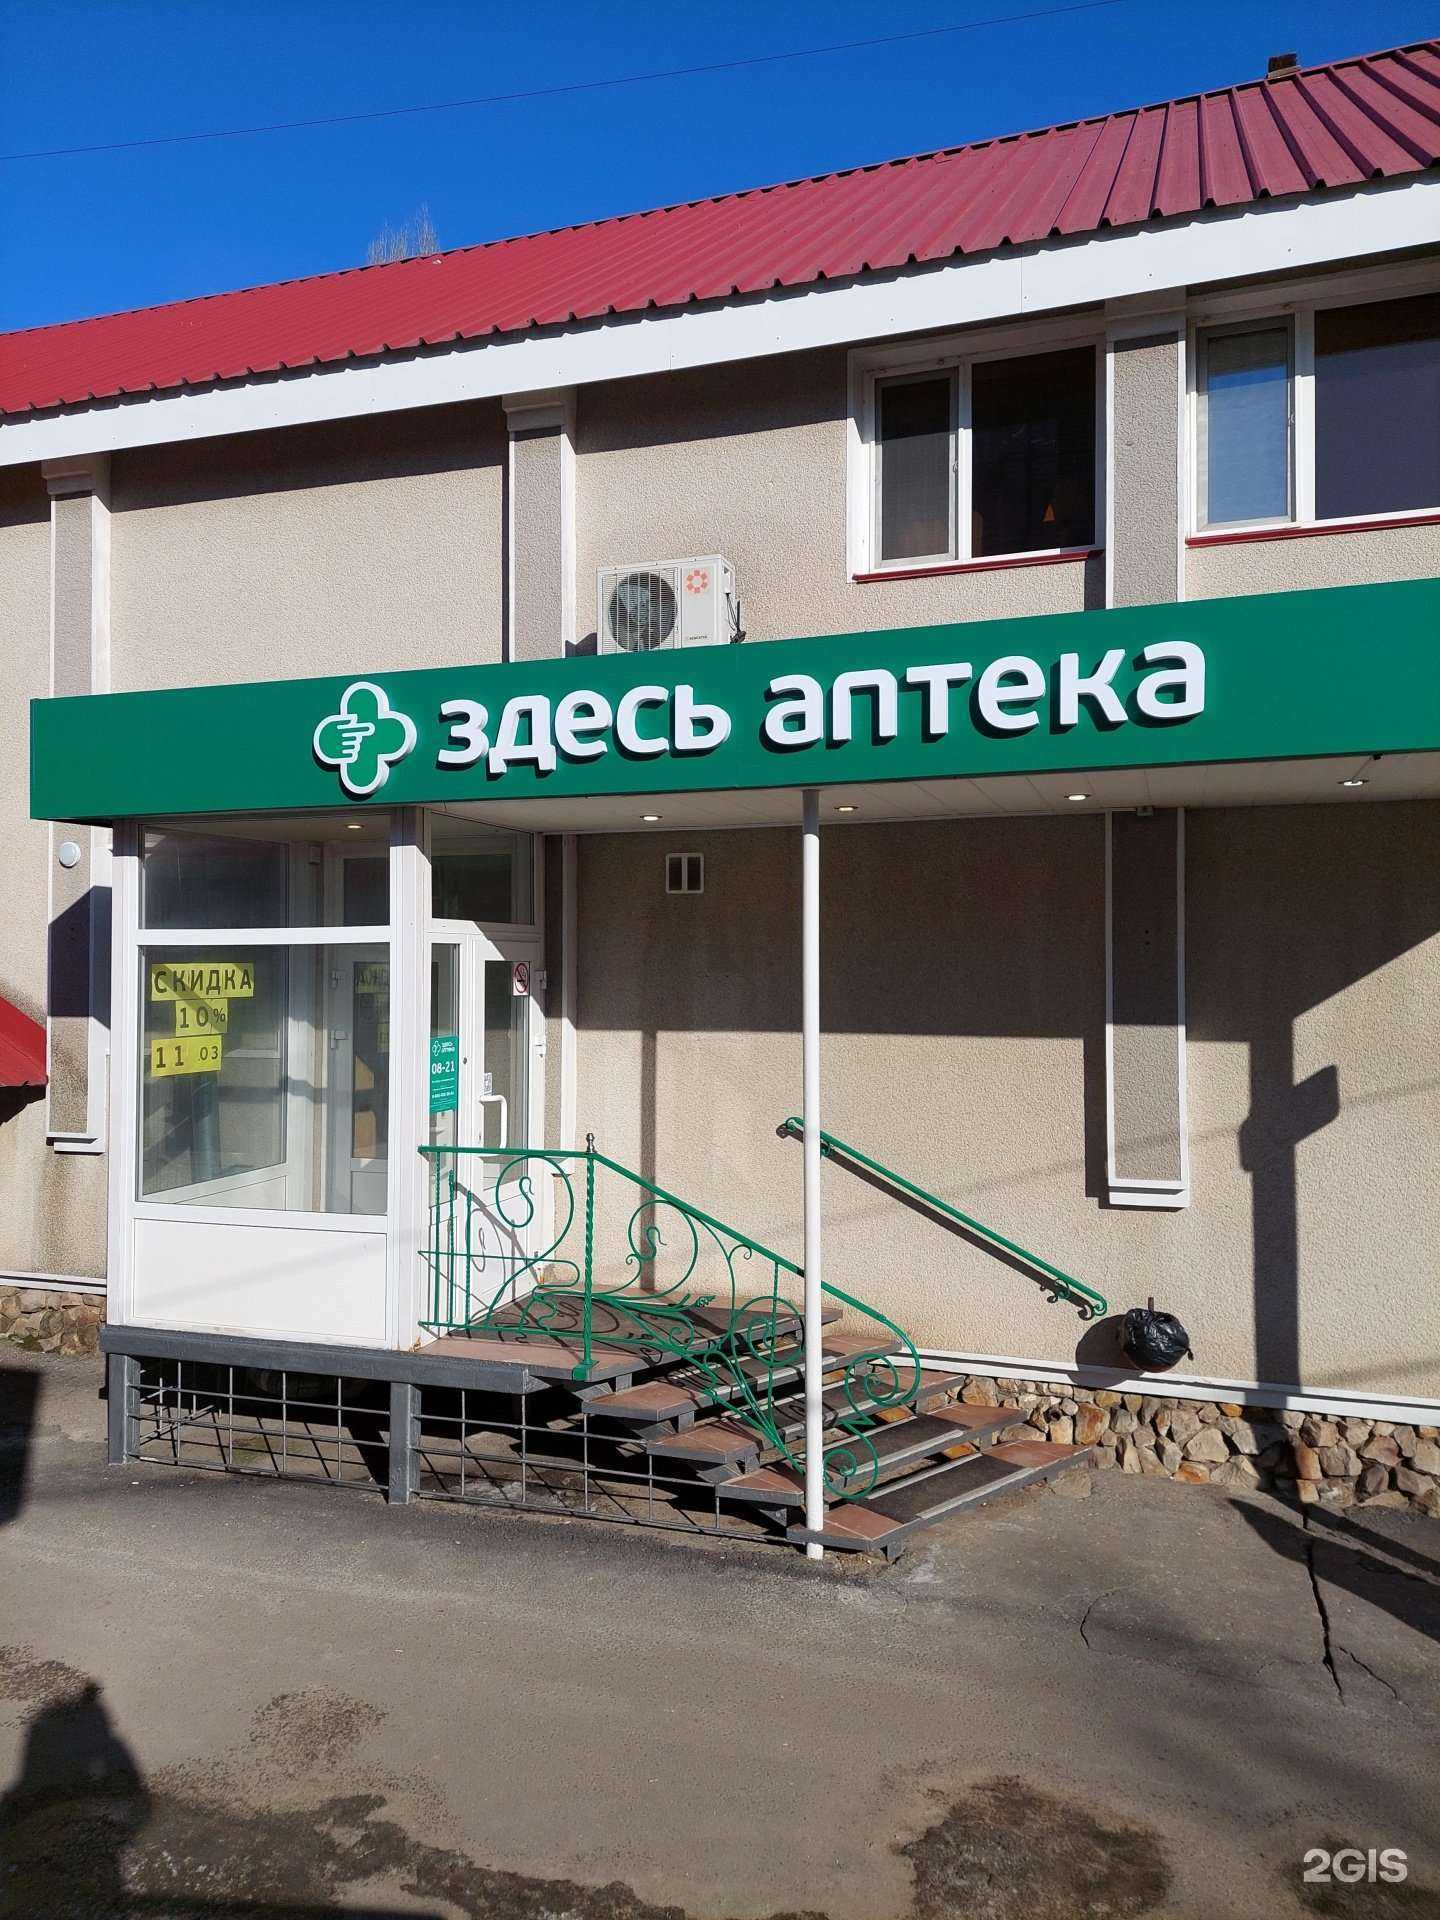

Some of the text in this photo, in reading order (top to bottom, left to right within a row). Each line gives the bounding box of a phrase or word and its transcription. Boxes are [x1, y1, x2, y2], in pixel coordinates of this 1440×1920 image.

[438, 640, 1206, 774] здесь аптека
[154, 969, 252, 995] СКИДКА
[180, 1006, 226, 1029] 10%
[431, 1060, 455, 1074] 08-21
